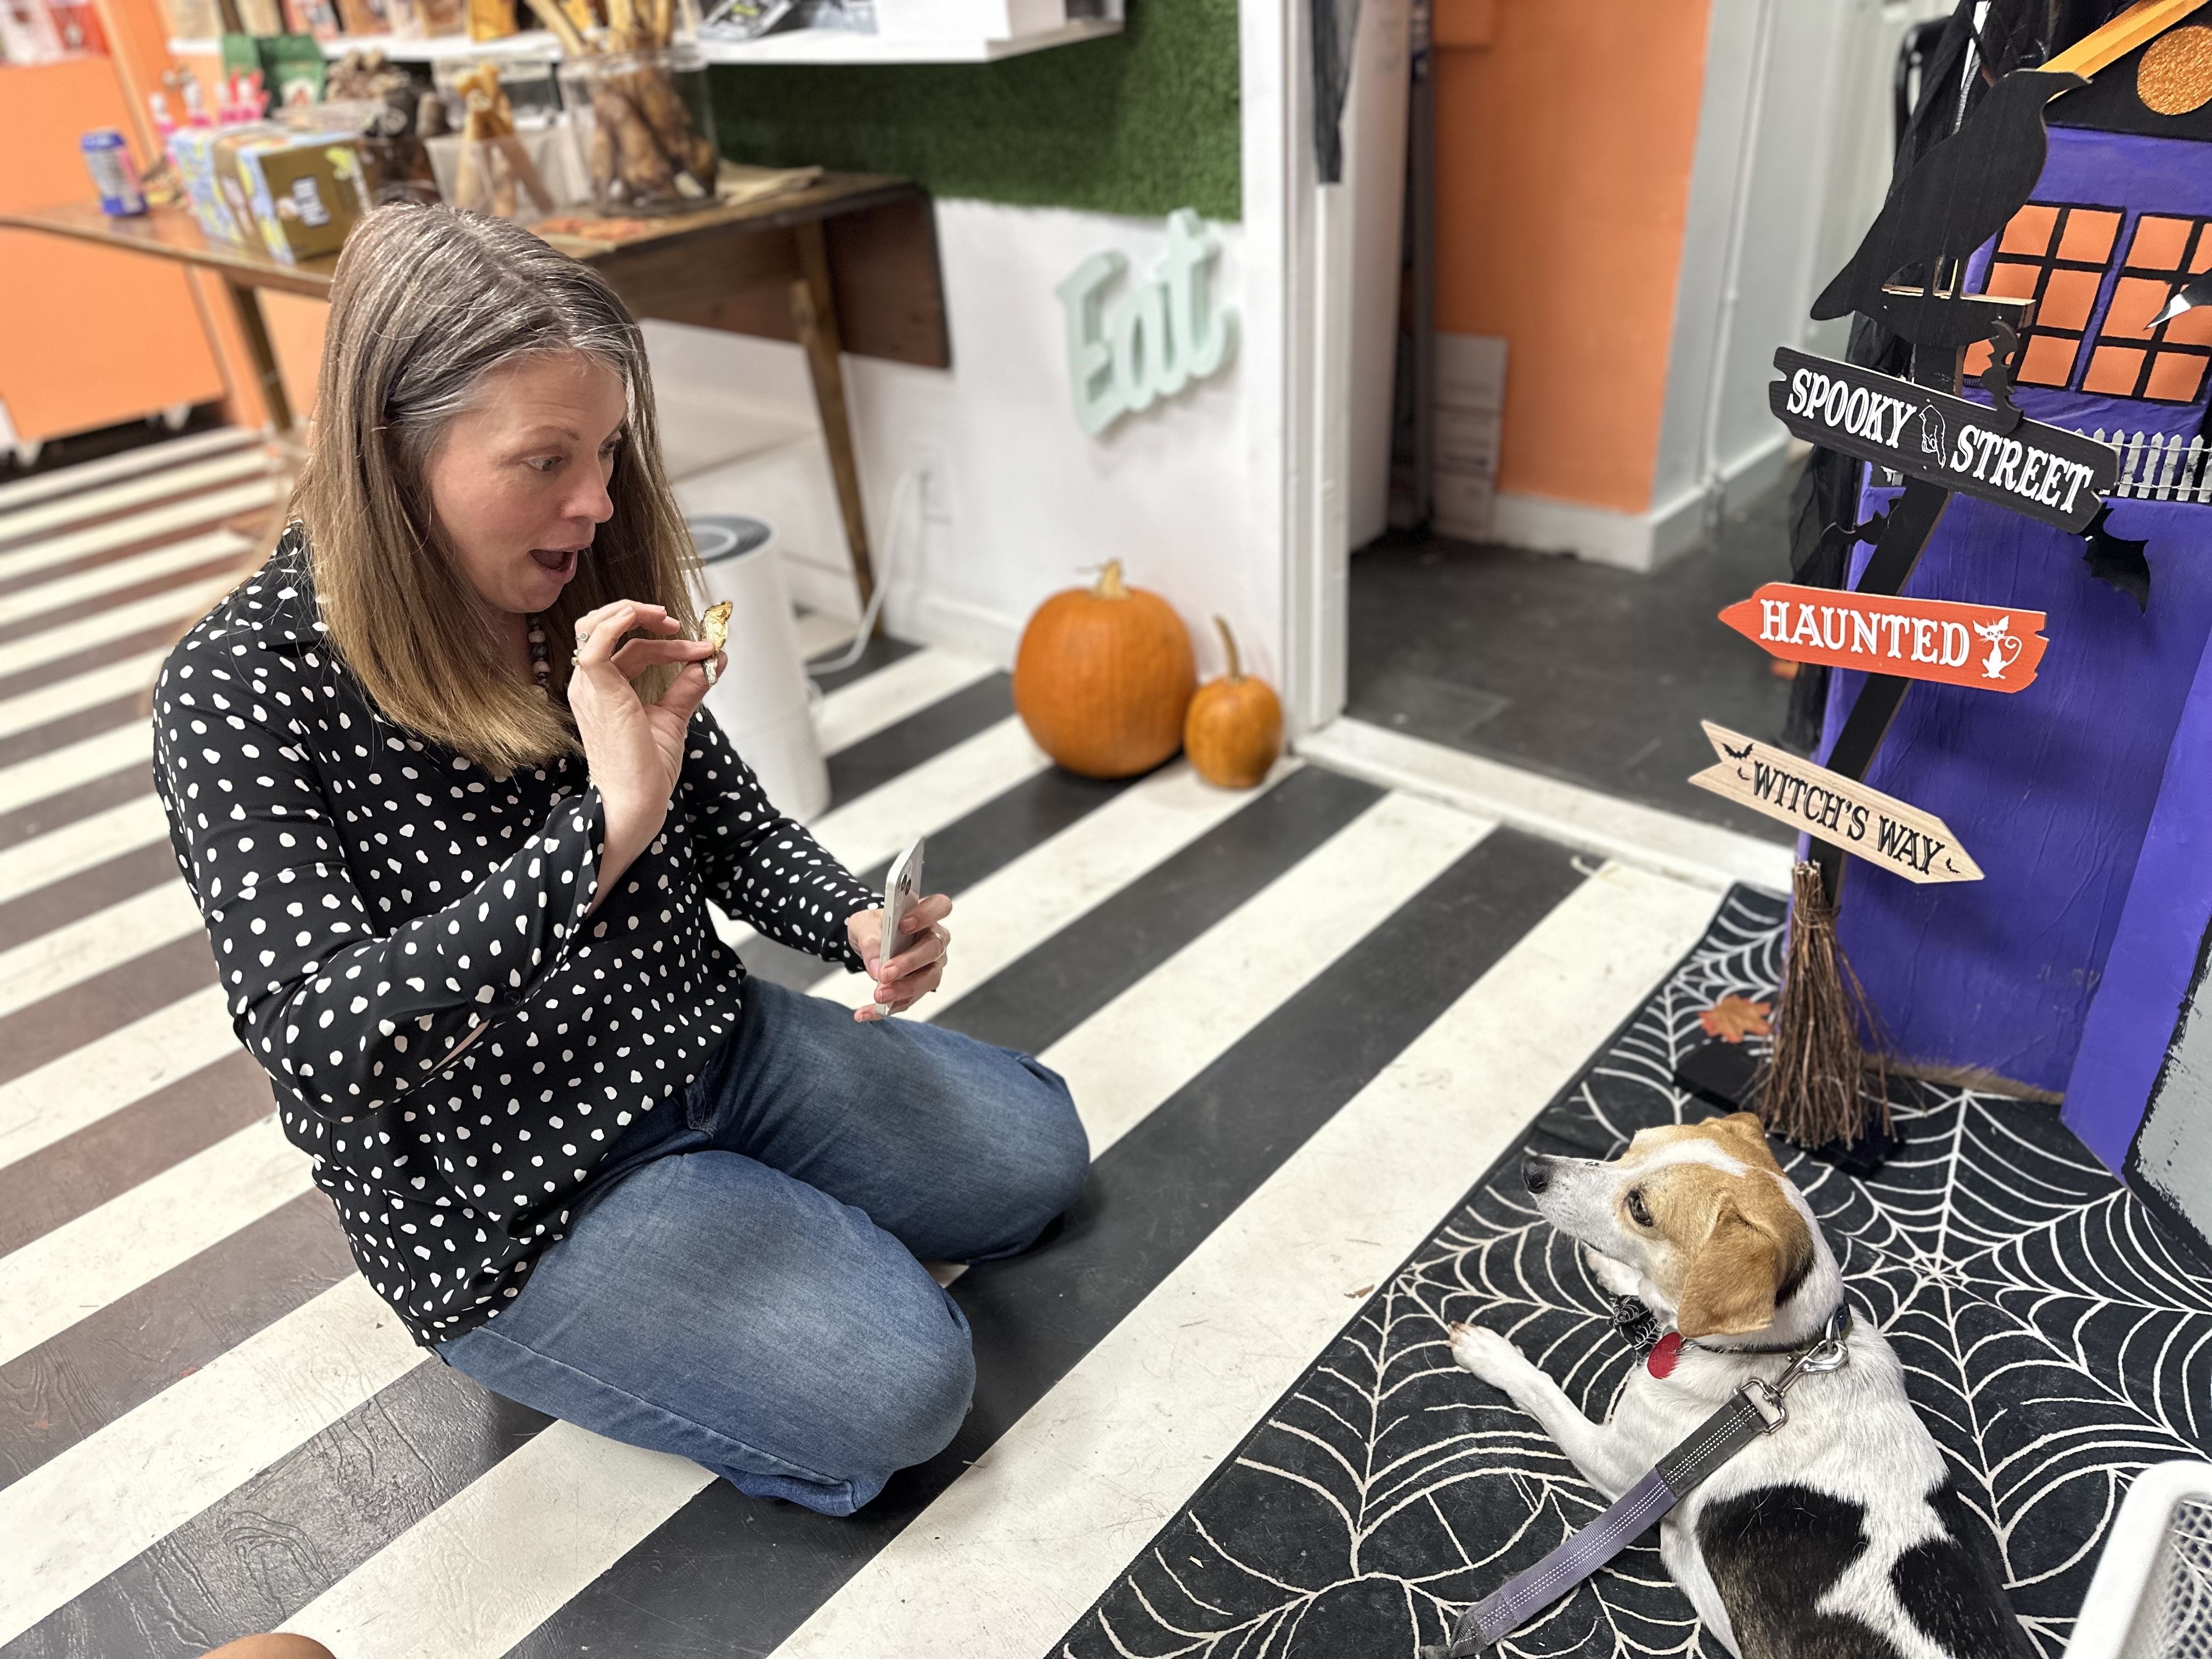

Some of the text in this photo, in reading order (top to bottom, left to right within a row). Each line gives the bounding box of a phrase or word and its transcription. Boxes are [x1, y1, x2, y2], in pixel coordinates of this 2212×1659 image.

[1054, 206, 1241, 435] Eat
[1786, 368, 2095, 514] SPOOKY STREET
[1759, 599, 1970, 667] HAUNTED
[1753, 760, 1945, 875] WITCH'S WAY
